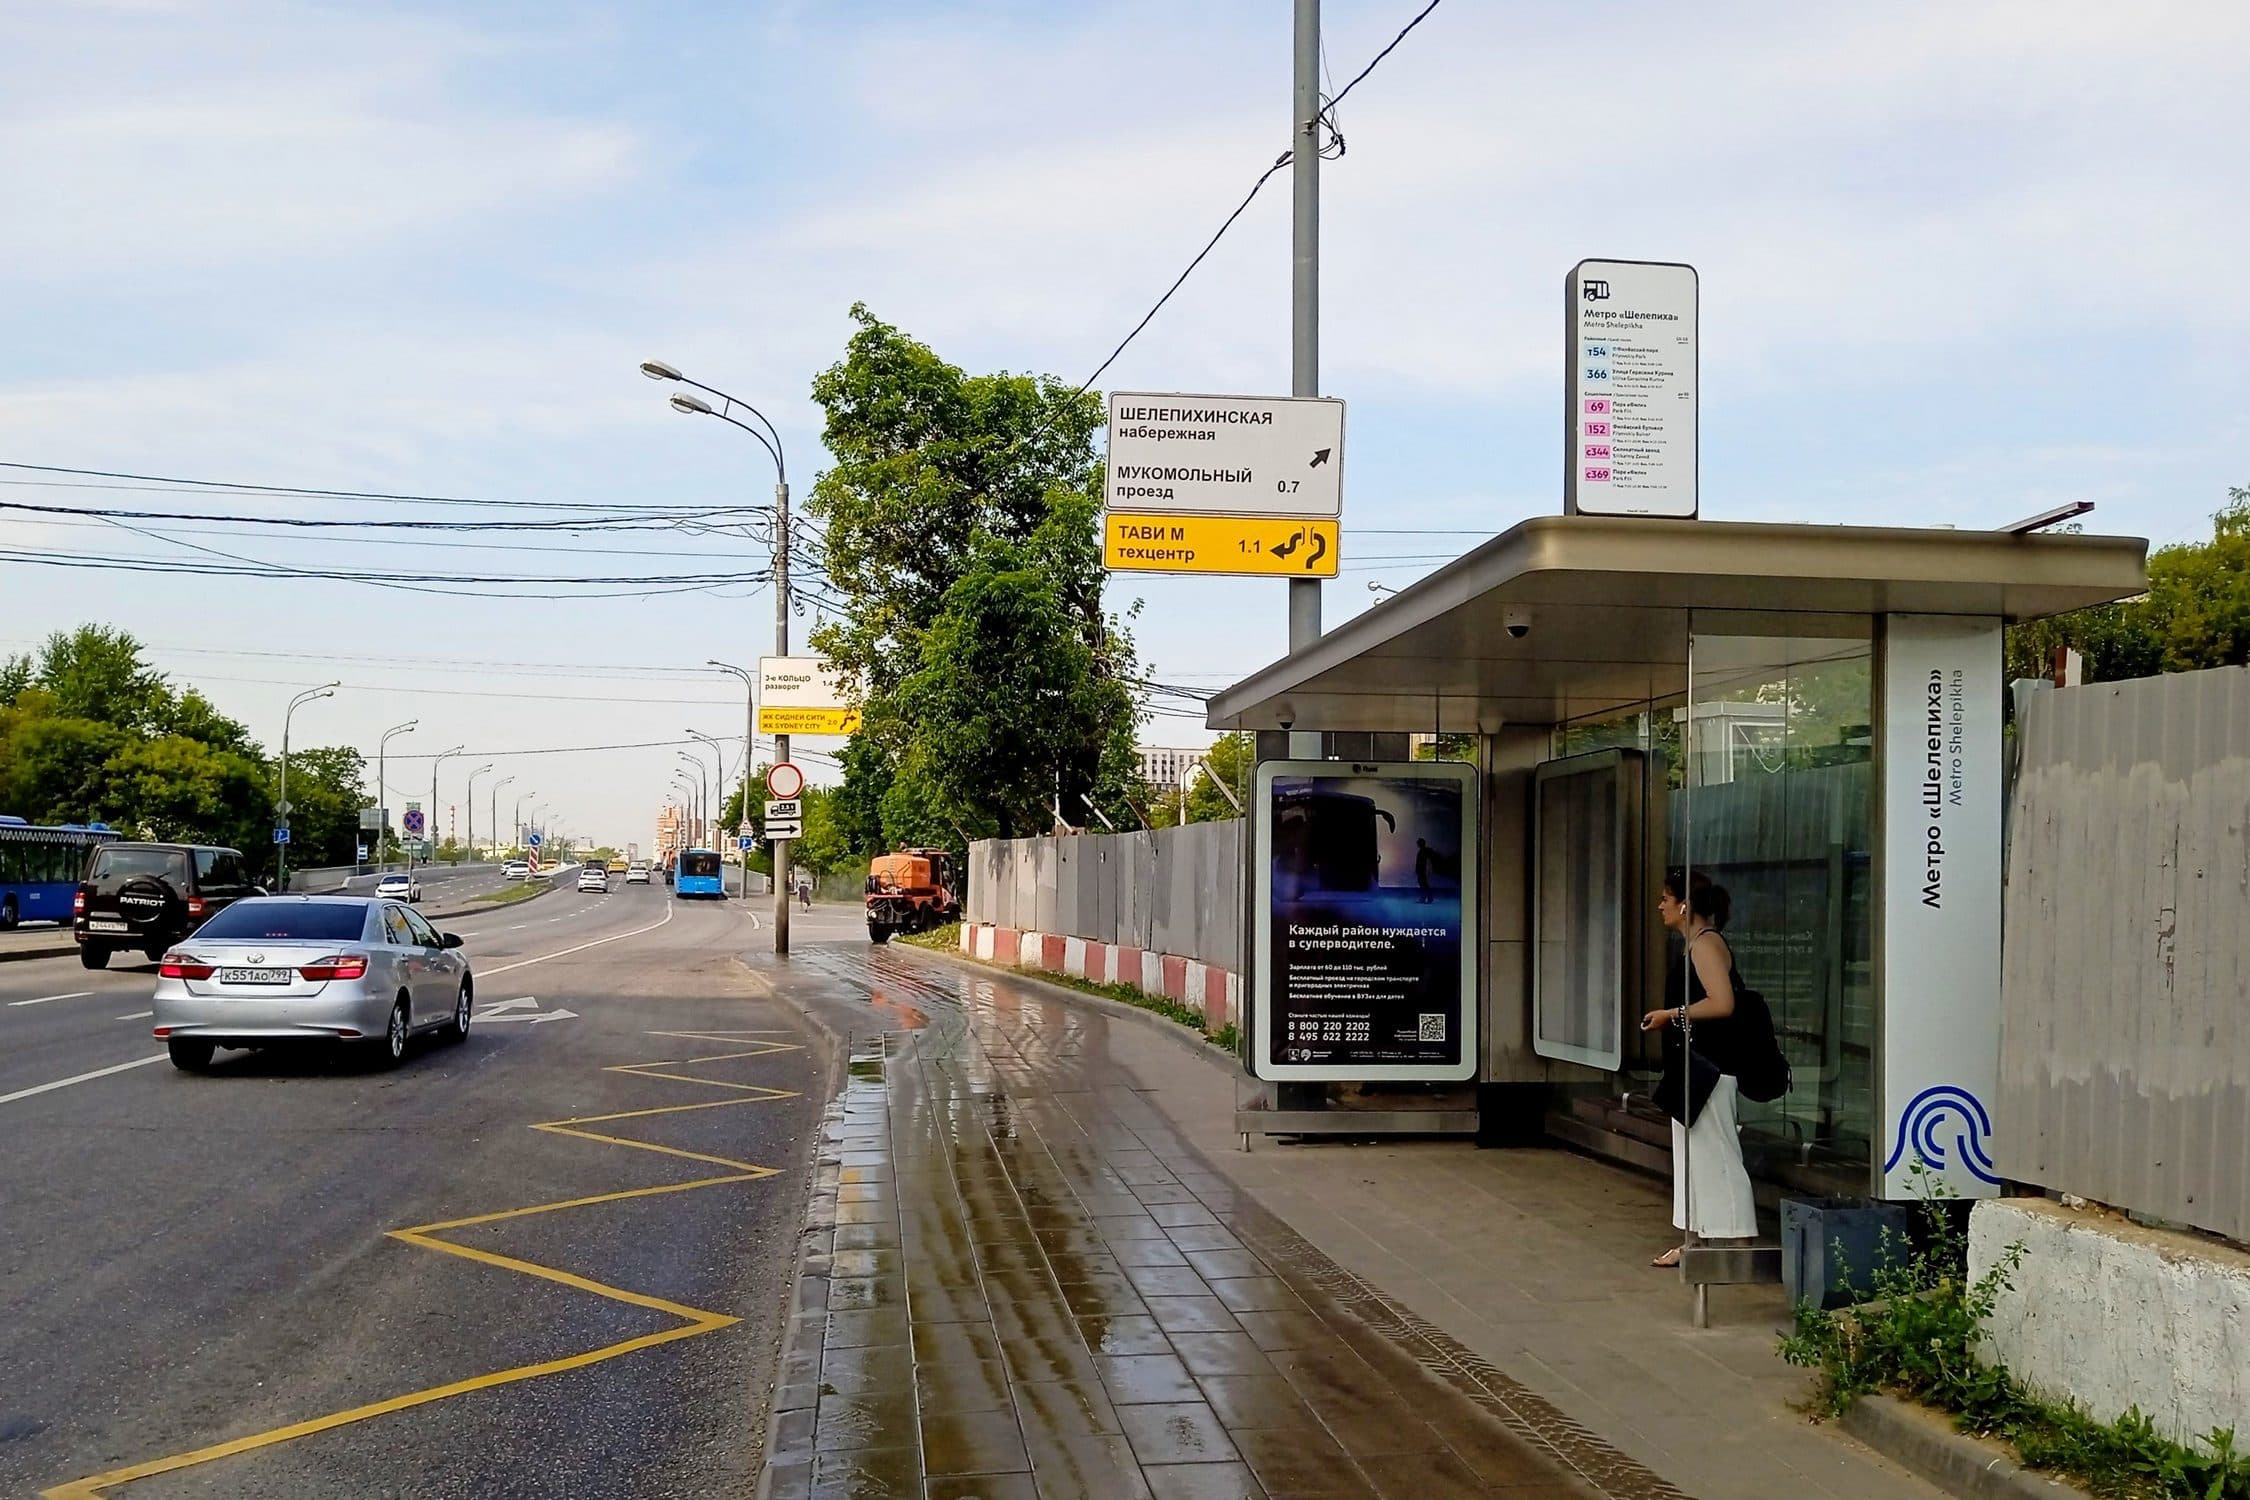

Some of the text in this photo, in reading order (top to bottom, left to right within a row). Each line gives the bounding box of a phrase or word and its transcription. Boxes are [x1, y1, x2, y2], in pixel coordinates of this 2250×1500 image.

[1583, 309, 1679, 321] Метро «Шелепиха»
[1606, 322, 1643, 330] Shelepikha
[1587, 347, 1606, 356] т54
[1587, 369, 1607, 379] 366
[1590, 402, 1604, 412] 69
[1120, 407, 1273, 425] ШЕЛЕПИХИНСКАЯ
[1119, 426, 1216, 442] набережная
[1588, 425, 1606, 434] 152
[1586, 448, 1609, 456] с344
[1117, 466, 1252, 483] МУКОМОЛЬНЫЙ
[1586, 470, 1609, 479] с369
[1277, 480, 1300, 493] 0.7
[1116, 486, 1174, 500] проезд
[1118, 525, 1184, 541] ТАВИ М
[1238, 540, 1261, 554] 1.1
[1118, 547, 1195, 563] техцентр
[778, 675, 811, 683] КОЛЬЦО
[774, 713, 805, 721] СИДНЕЙ
[1949, 669, 1964, 806] Metro Shelepikha
[1922, 669, 1945, 909] Метро «Шелепиха»
[120, 896, 166, 907] PATRIOT
[1289, 924, 1447, 938] Каждый район нуждается
[1289, 939, 1395, 951] в суперводителе.
[271, 970, 287, 979] 799
[1288, 1022, 1370, 1031] 8 800 220 2202
[1288, 1032, 1370, 1041] 8 495 622 2222
